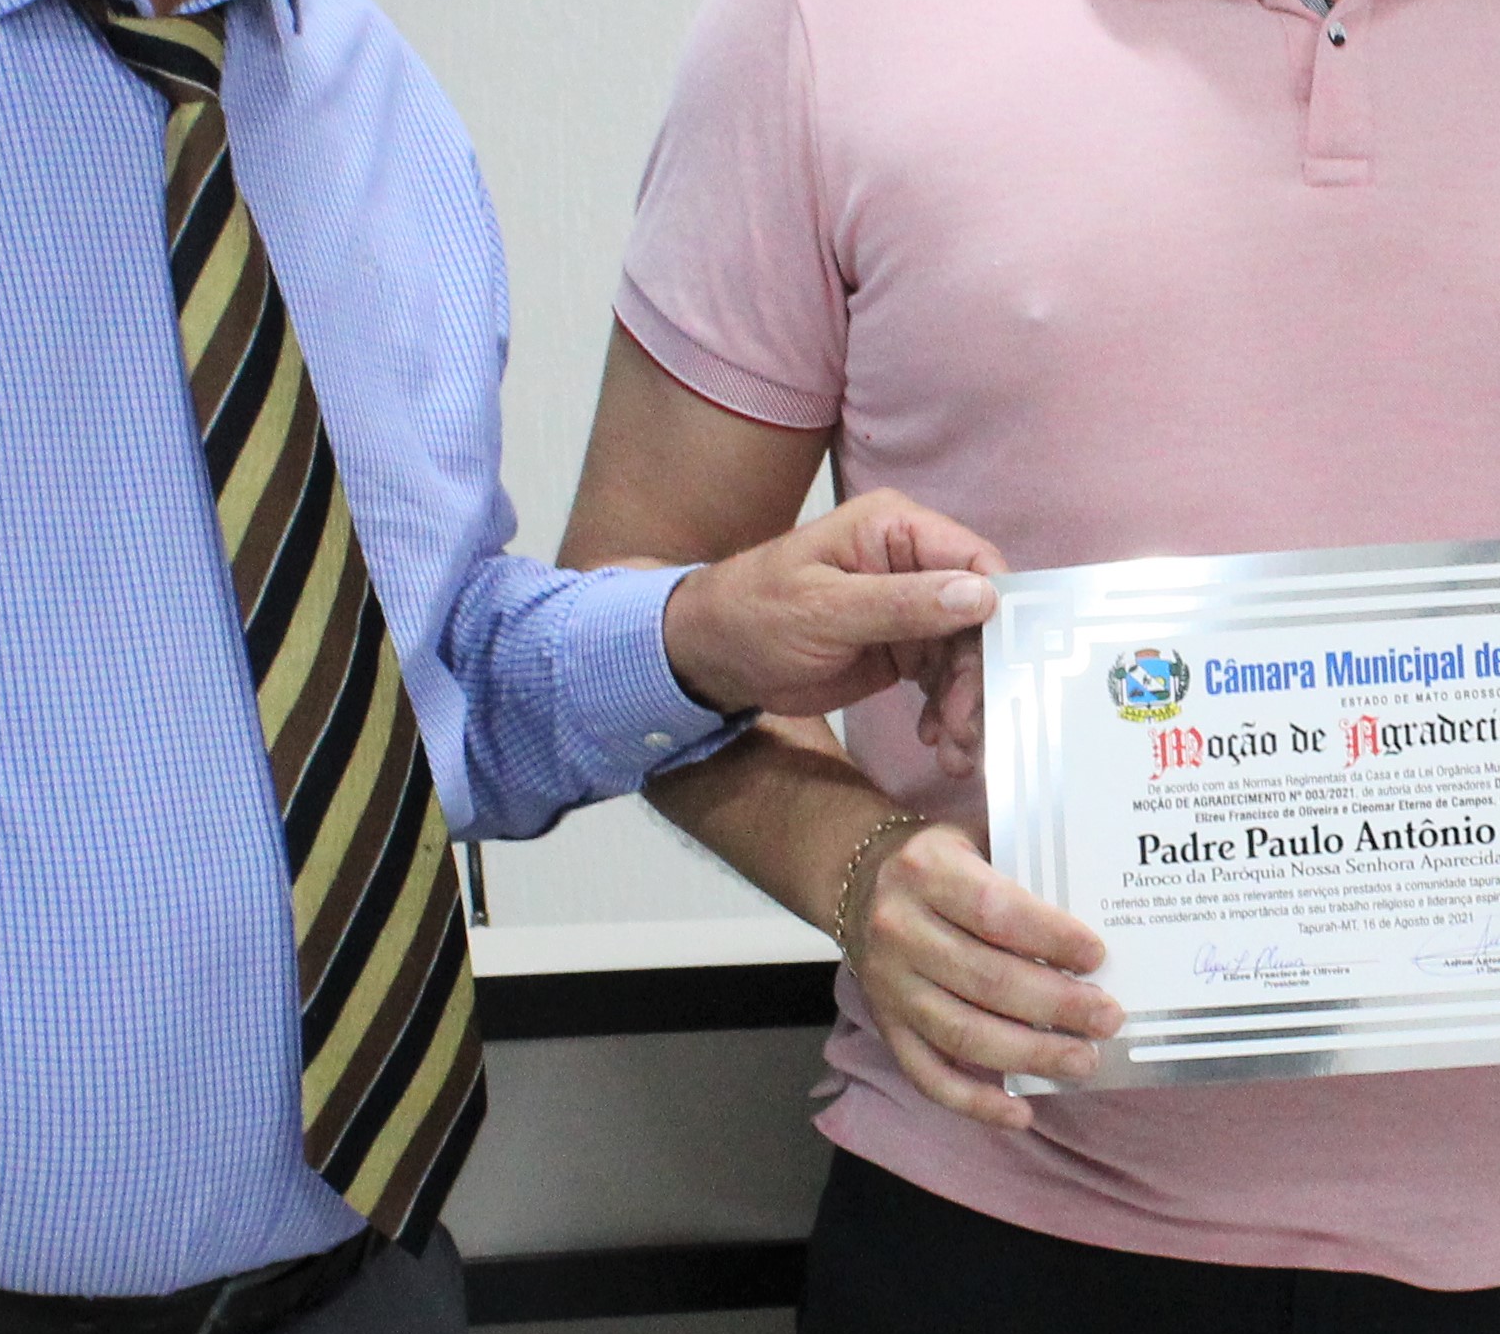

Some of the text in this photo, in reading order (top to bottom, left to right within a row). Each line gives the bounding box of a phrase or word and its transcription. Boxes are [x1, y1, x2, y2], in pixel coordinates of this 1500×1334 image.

[1205, 659, 1315, 695] Câmara
[1325, 644, 1464, 687] Municipal
[1341, 695, 1388, 708] ESTADO
[1394, 693, 1409, 705] DE
[1416, 692, 1448, 702] MATO
[1149, 723, 1277, 780] Moção
[1290, 723, 1326, 754] de
[1133, 797, 1172, 813] MOÇÃO
[1176, 797, 1189, 809] DE
[1194, 792, 1286, 807] AGRADECIMENTO
[1362, 785, 1374, 797] de
[1414, 779, 1434, 795] dos
[1164, 781, 1199, 794] acordo
[1202, 781, 1225, 792] com
[1243, 777, 1282, 791] Normas
[1350, 771, 1365, 782] da
[1365, 770, 1394, 782] Casa
[1403, 768, 1416, 779] da
[1229, 809, 1279, 822] Francisco
[1283, 807, 1295, 818] de
[1399, 800, 1432, 811] Eterno
[1436, 798, 1448, 808] de
[1138, 832, 1234, 865] Padre
[1246, 824, 1343, 858] Paulo
[1355, 816, 1495, 852] Antônio
[1123, 872, 1182, 887] Pároco
[1186, 868, 1206, 884] da
[1211, 864, 1285, 884] Paróquia
[1291, 861, 1340, 878] Nossa
[1346, 856, 1415, 874] Senhora
[1379, 916, 1391, 929] de
[1394, 915, 1429, 929] Agosto
[1433, 913, 1445, 925] de
